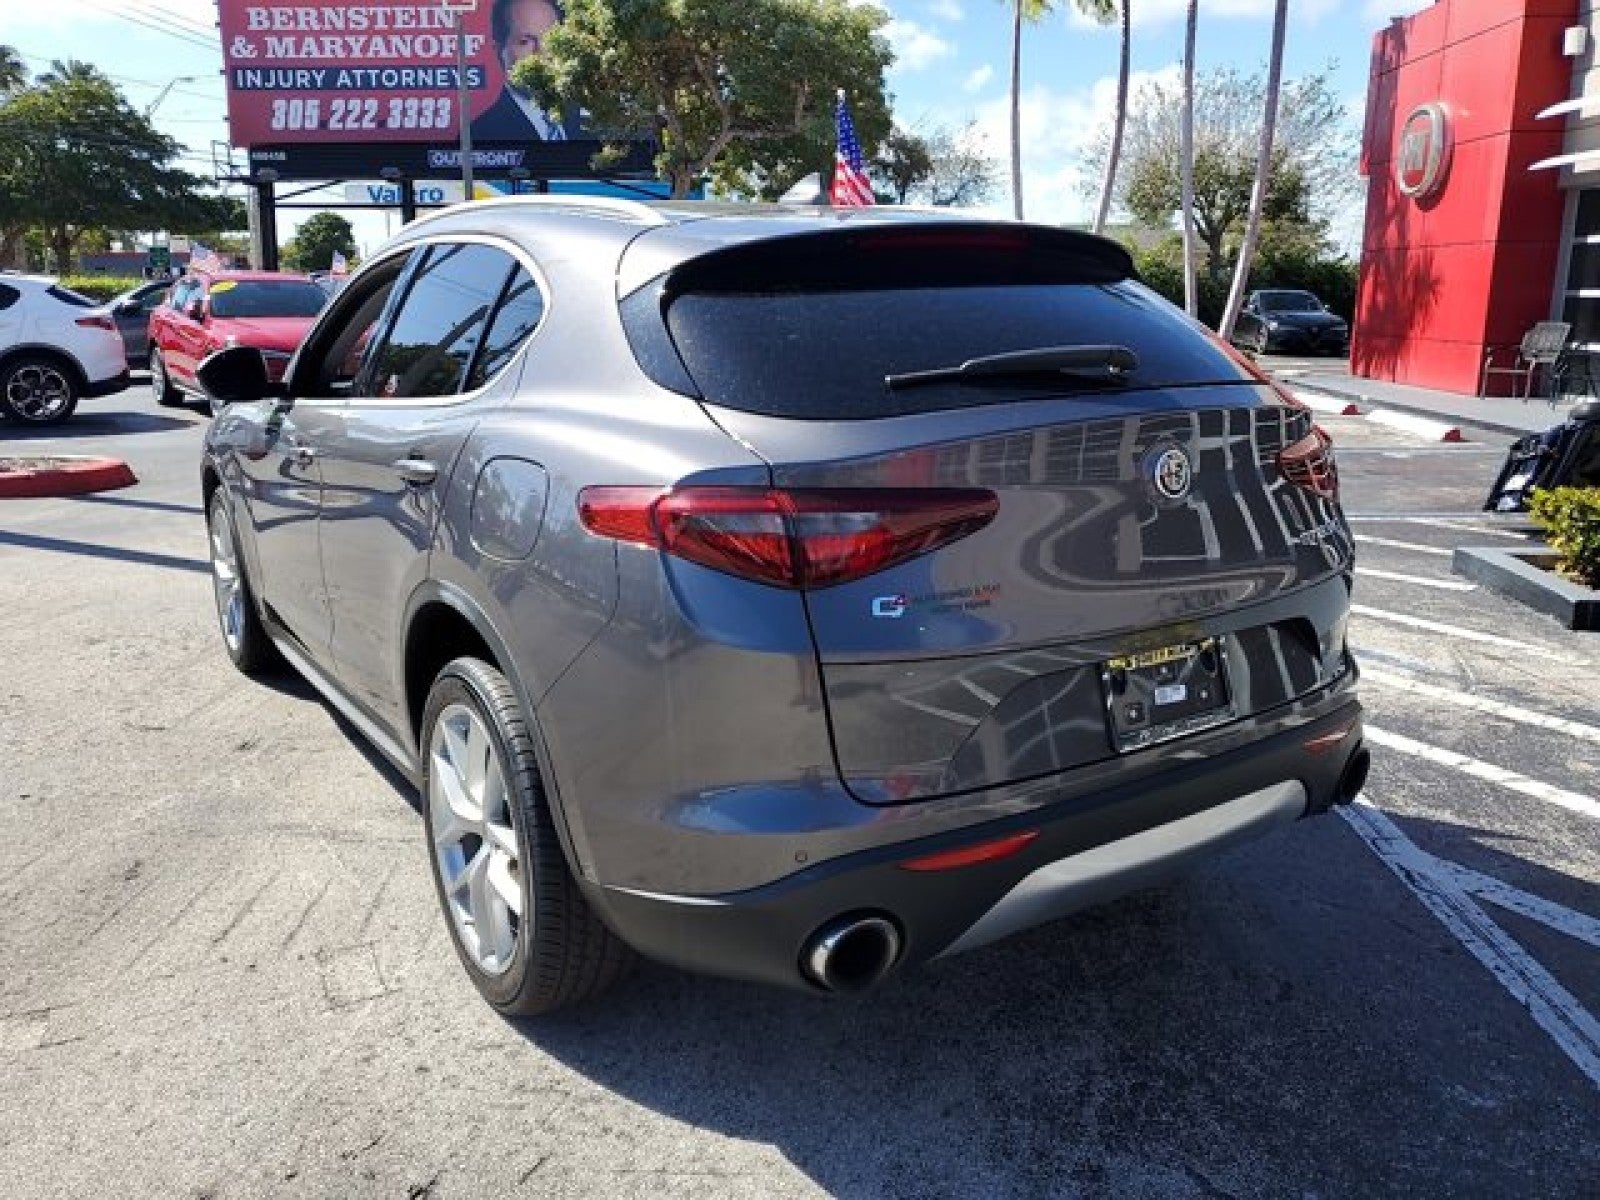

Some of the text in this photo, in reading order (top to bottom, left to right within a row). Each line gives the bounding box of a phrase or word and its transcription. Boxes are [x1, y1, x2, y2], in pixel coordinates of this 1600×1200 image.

[245, 6, 456, 30] BERNSTEIN
[230, 35, 485, 58] & MARYANOFF
[237, 69, 481, 88] INJURY ATTORNEYS
[367, 184, 443, 202] Valro
